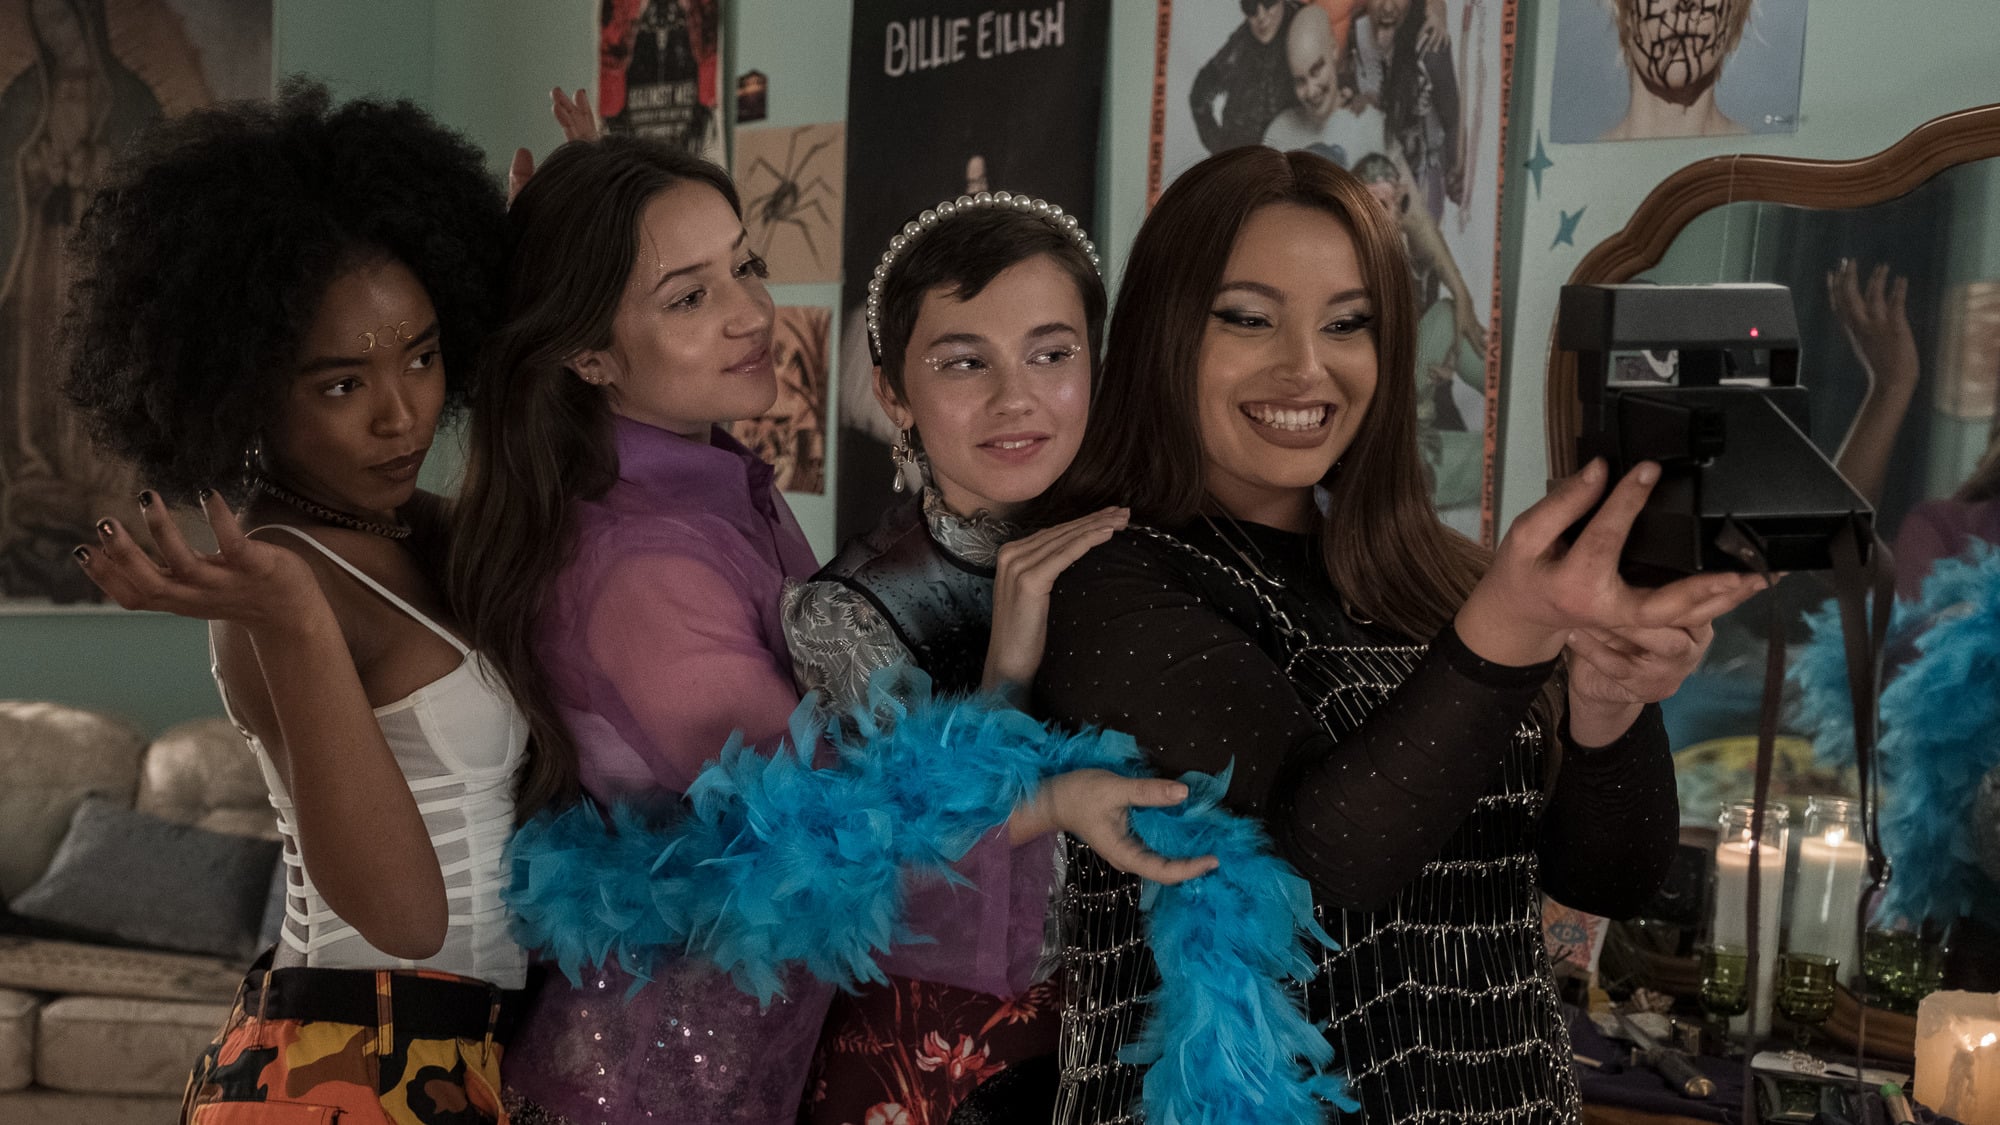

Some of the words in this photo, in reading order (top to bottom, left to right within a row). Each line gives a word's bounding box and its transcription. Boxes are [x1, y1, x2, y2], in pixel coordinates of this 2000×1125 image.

[884, 15, 970, 77] BILLIE
[977, 1, 1065, 59] EILISH
[1489, 317, 1500, 389] FEVER
